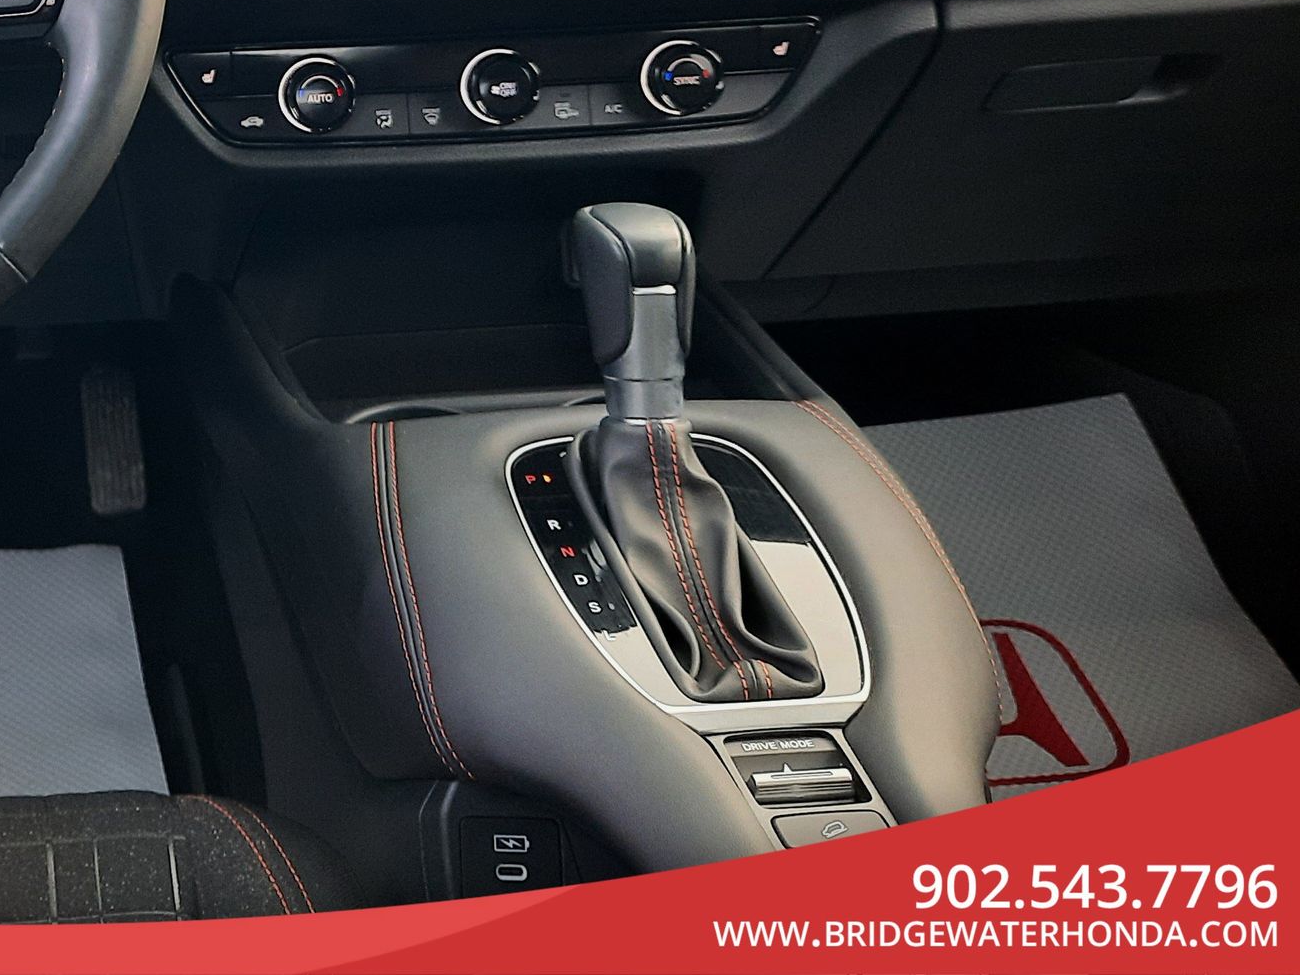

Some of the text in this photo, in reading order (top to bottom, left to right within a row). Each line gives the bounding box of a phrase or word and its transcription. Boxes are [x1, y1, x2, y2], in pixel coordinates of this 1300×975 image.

[307, 93, 333, 104] AUTO
[604, 103, 623, 114] A/C
[525, 475, 536, 485] P
[547, 519, 561, 531] R
[560, 546, 576, 558] N
[573, 574, 589, 586] D
[588, 601, 602, 613] S
[741, 739, 815, 752] DRIVE MODE
